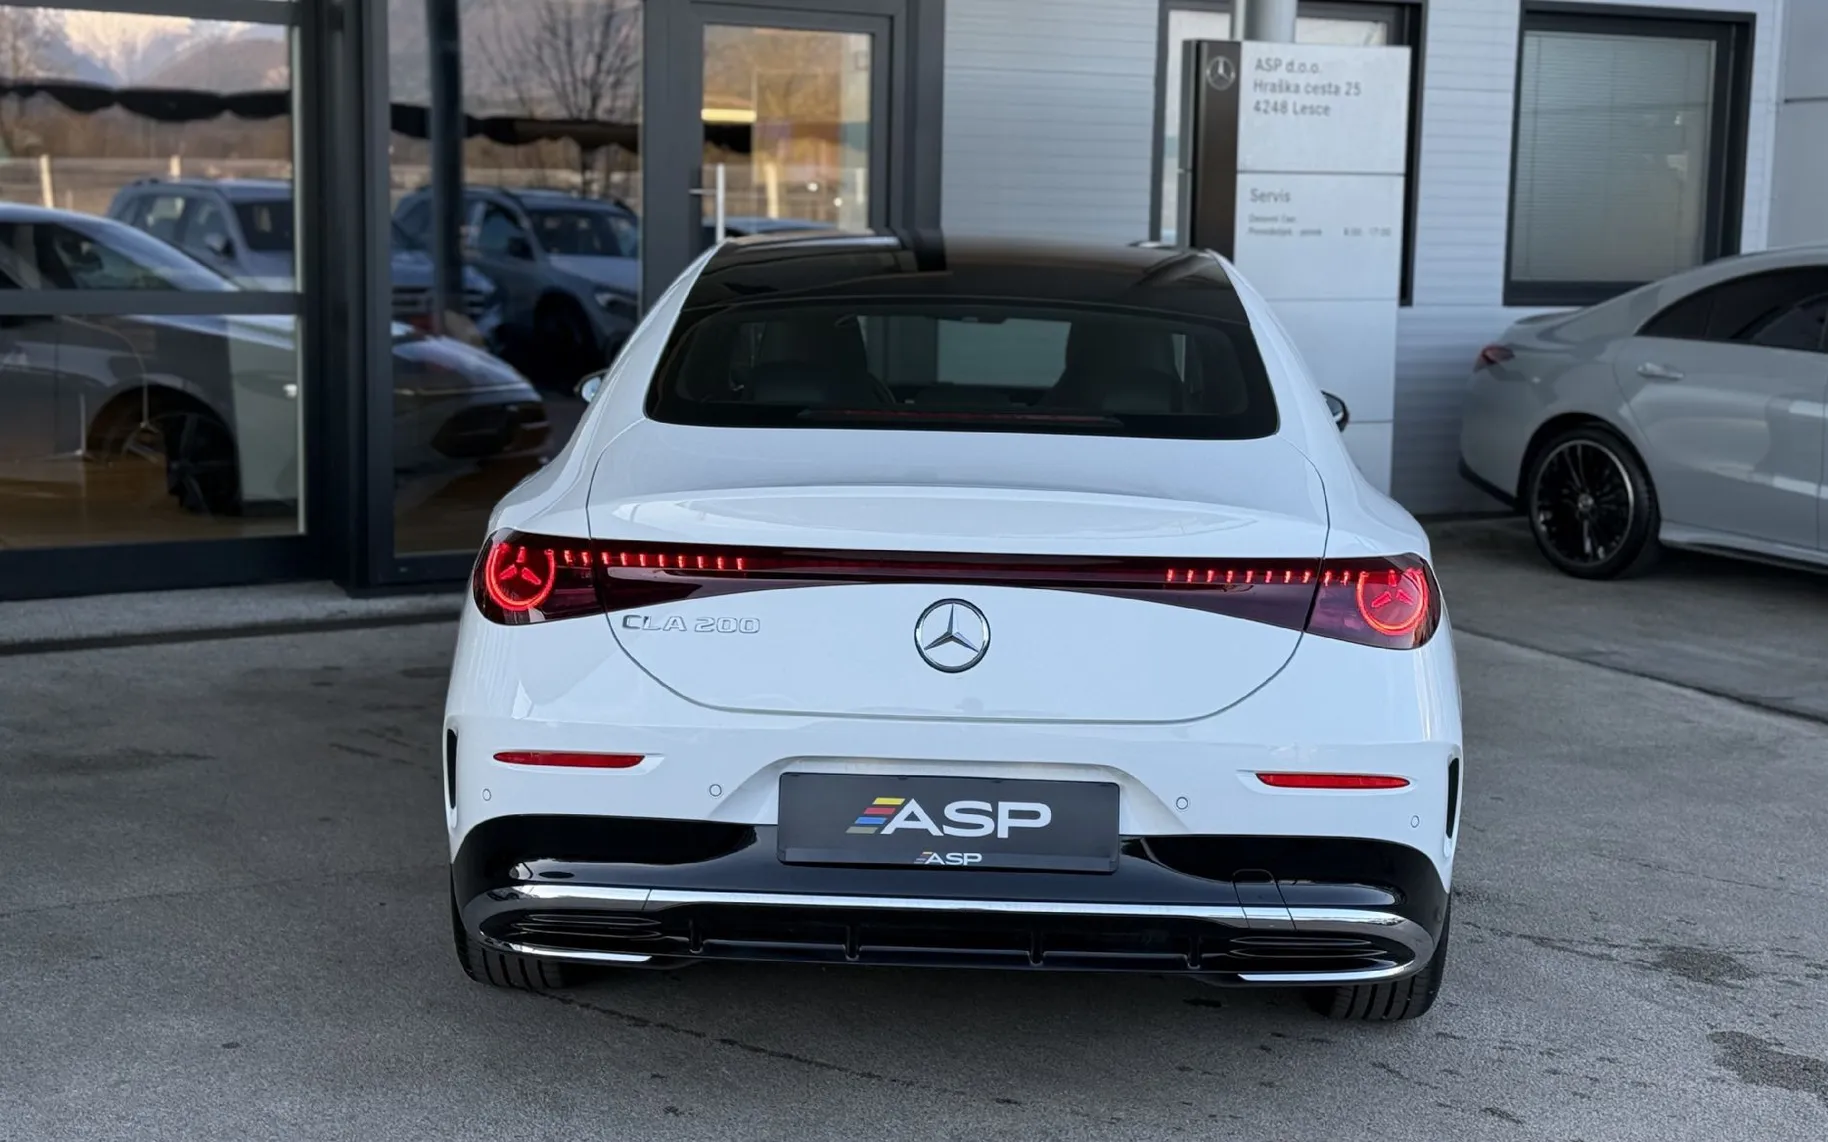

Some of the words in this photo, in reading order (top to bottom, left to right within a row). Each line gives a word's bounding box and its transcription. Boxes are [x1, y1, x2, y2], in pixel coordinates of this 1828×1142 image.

[1255, 57, 1282, 72] ASP
[1285, 58, 1322, 74] d.o.o.
[1253, 78, 1300, 94] Hraška
[1304, 81, 1341, 96] cesta
[1344, 81, 1361, 96] 25
[1253, 99, 1288, 115] 4248
[1292, 100, 1331, 117] Lesce
[1250, 187, 1291, 203] Servis
[622, 614, 687, 632] CLA
[694, 616, 760, 634] 200
[880, 798, 1051, 838] ASP
[924, 852, 982, 866] ASP
